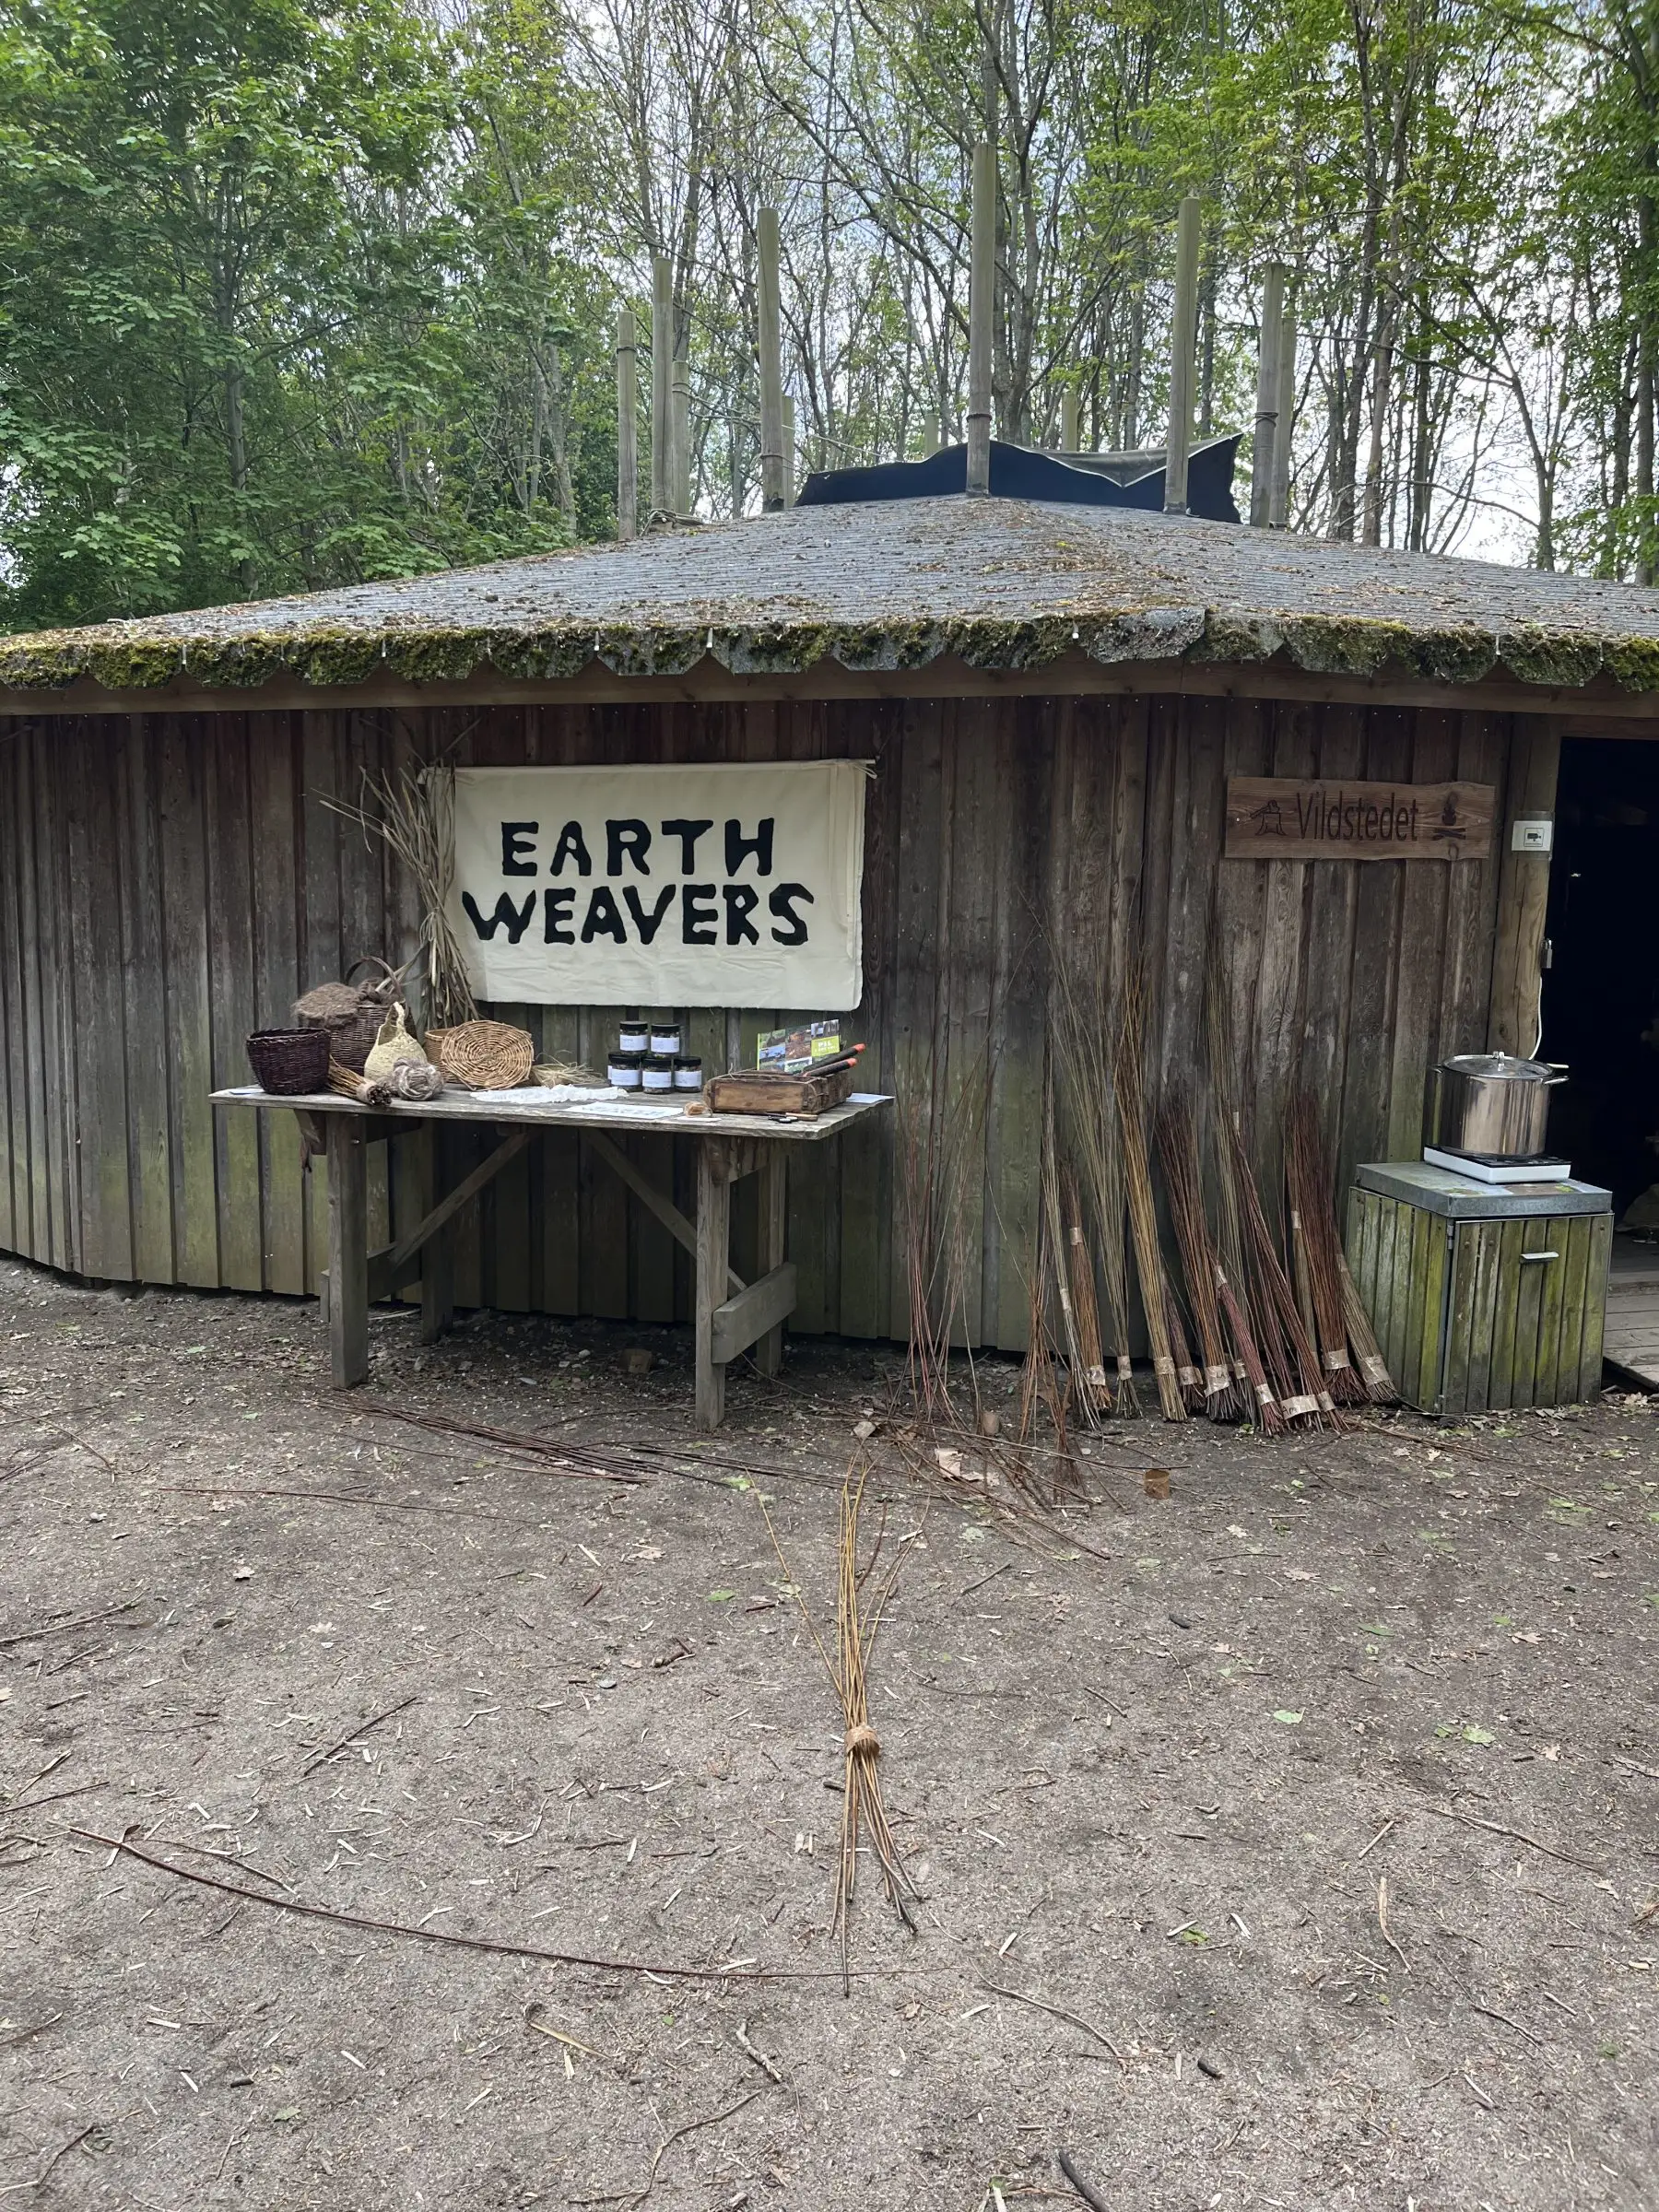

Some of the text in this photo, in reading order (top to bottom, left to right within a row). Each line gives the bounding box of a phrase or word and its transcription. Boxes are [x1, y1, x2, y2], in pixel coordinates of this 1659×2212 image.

[1296, 790, 1419, 841] Vildstedet
[501, 818, 775, 877] EARTH
[462, 883, 815, 947] WEAVERS
